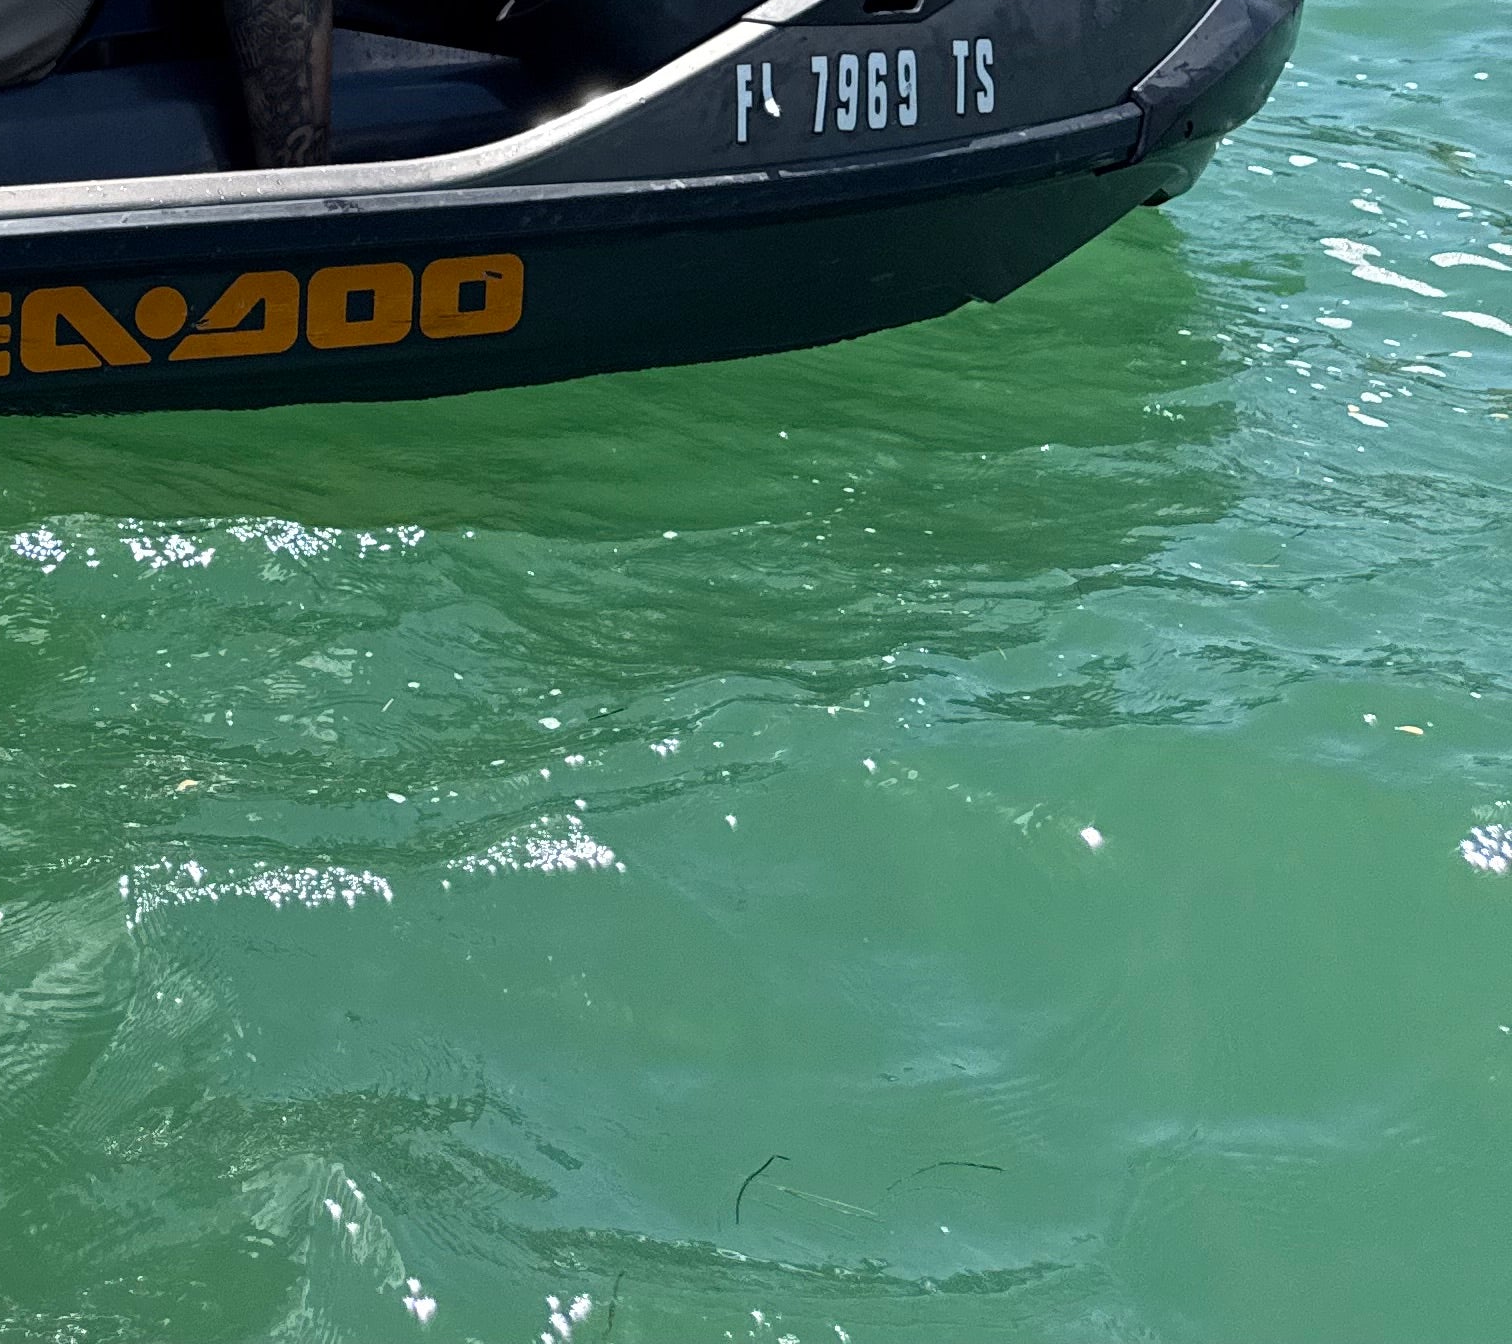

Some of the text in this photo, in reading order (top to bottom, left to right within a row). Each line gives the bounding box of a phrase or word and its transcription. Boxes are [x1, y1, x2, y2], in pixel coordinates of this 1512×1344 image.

[737, 38, 995, 142] FL 7969 TS
